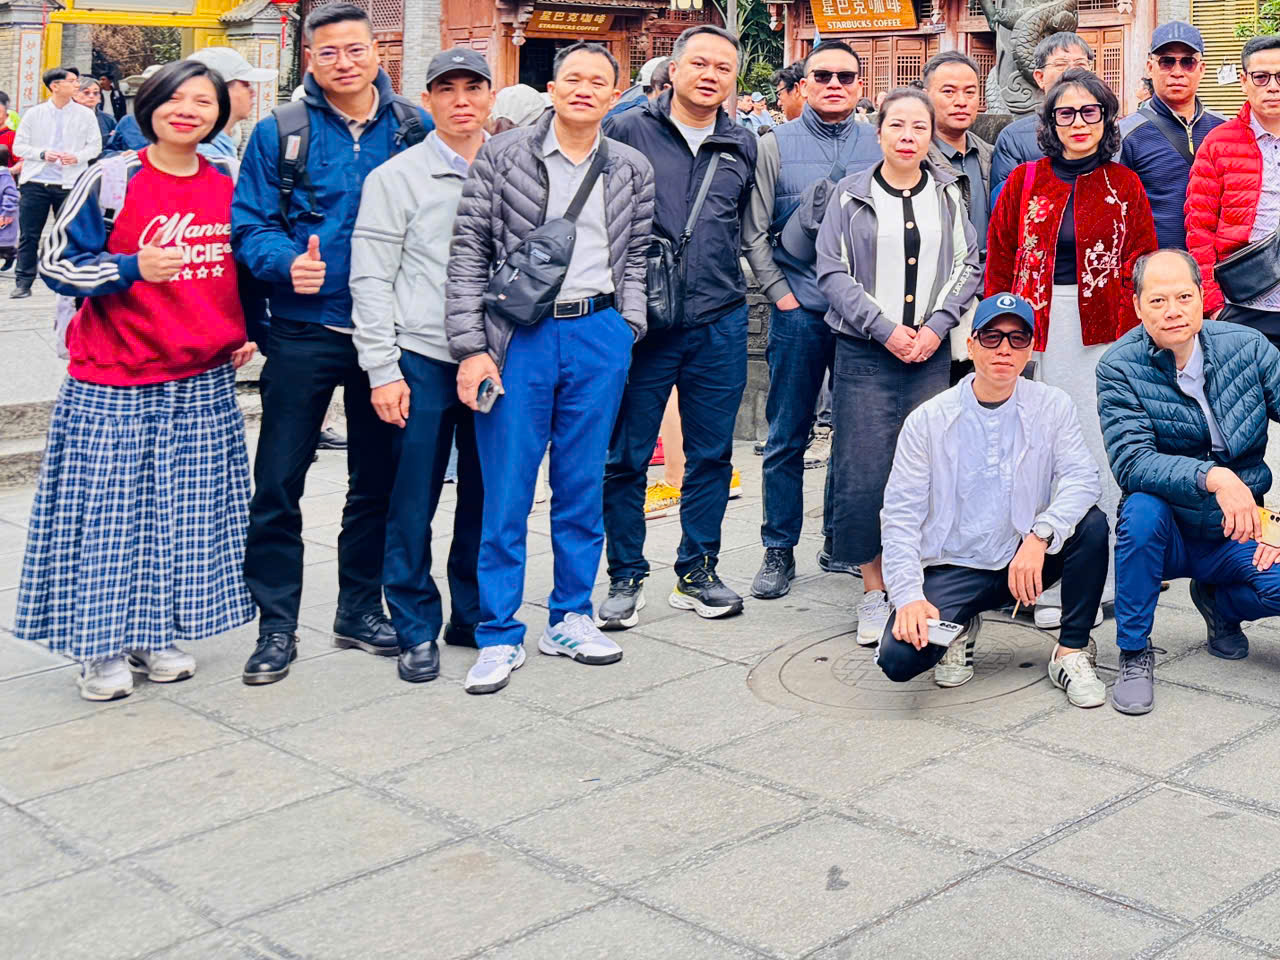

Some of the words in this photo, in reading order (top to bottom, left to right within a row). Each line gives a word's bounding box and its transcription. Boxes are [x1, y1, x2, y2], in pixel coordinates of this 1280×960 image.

[540, 11, 606, 24] 星巴克咖啡
[827, 20, 872, 29] STARBUCKS
[873, 19, 902, 27] COFFEE
